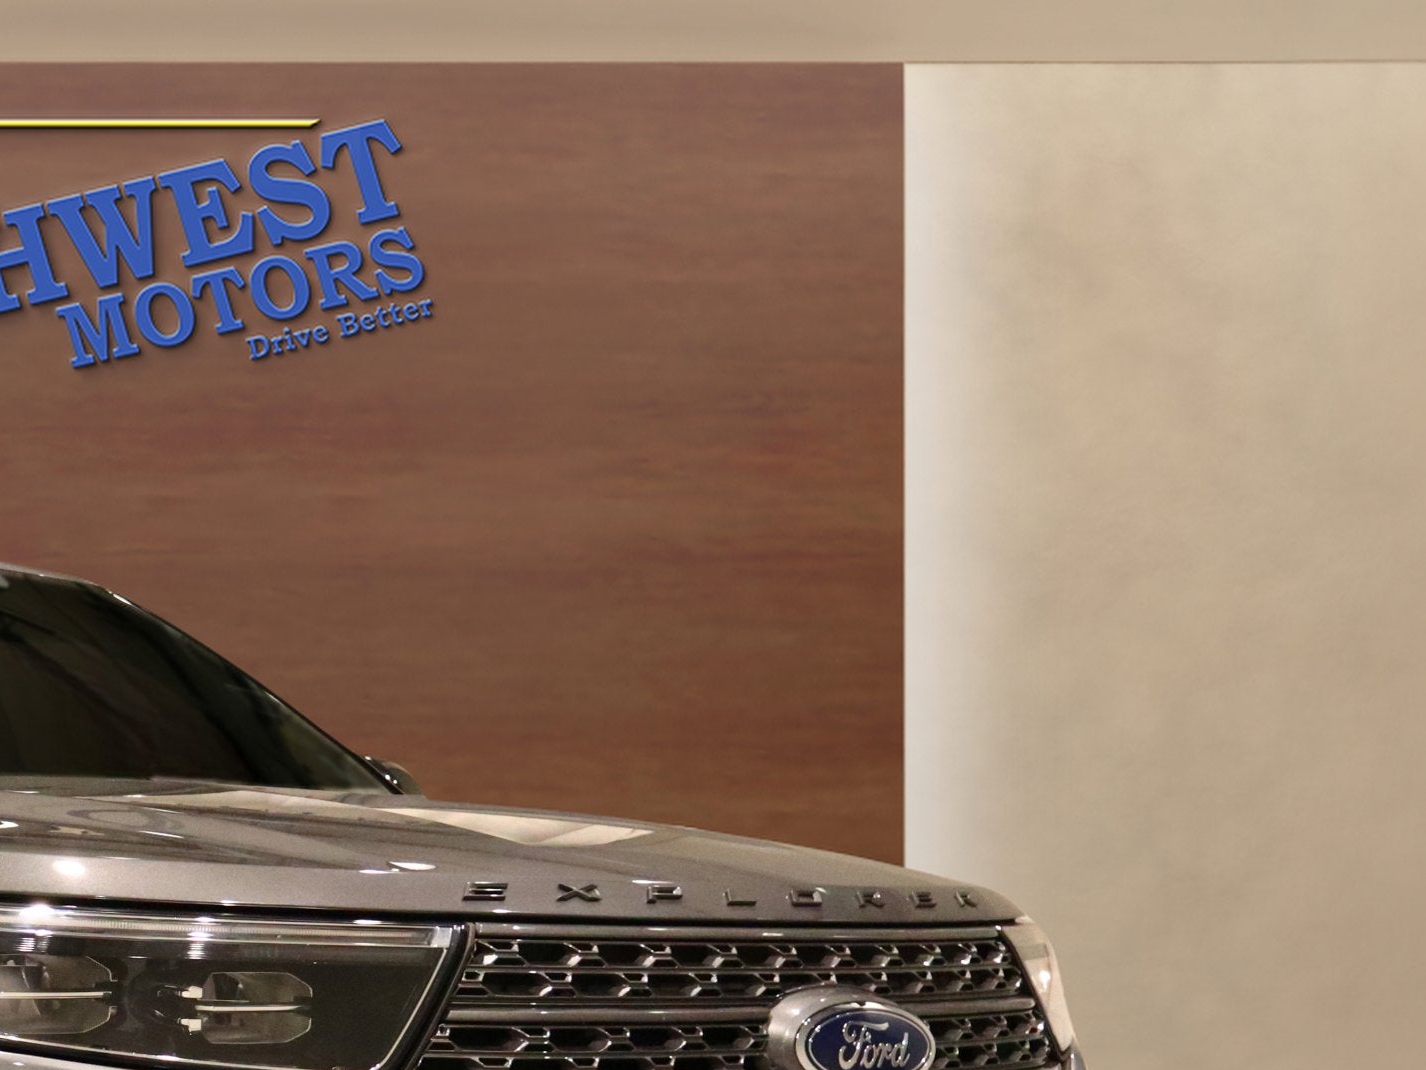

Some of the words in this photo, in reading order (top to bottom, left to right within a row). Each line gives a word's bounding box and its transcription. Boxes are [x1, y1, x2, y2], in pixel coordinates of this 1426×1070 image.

[56, 227, 425, 368] MOTORS
[245, 325, 330, 360] Drive
[336, 299, 435, 338] Better
[462, 882, 978, 908] EXPLORER
[838, 1020, 910, 1070] Ford
